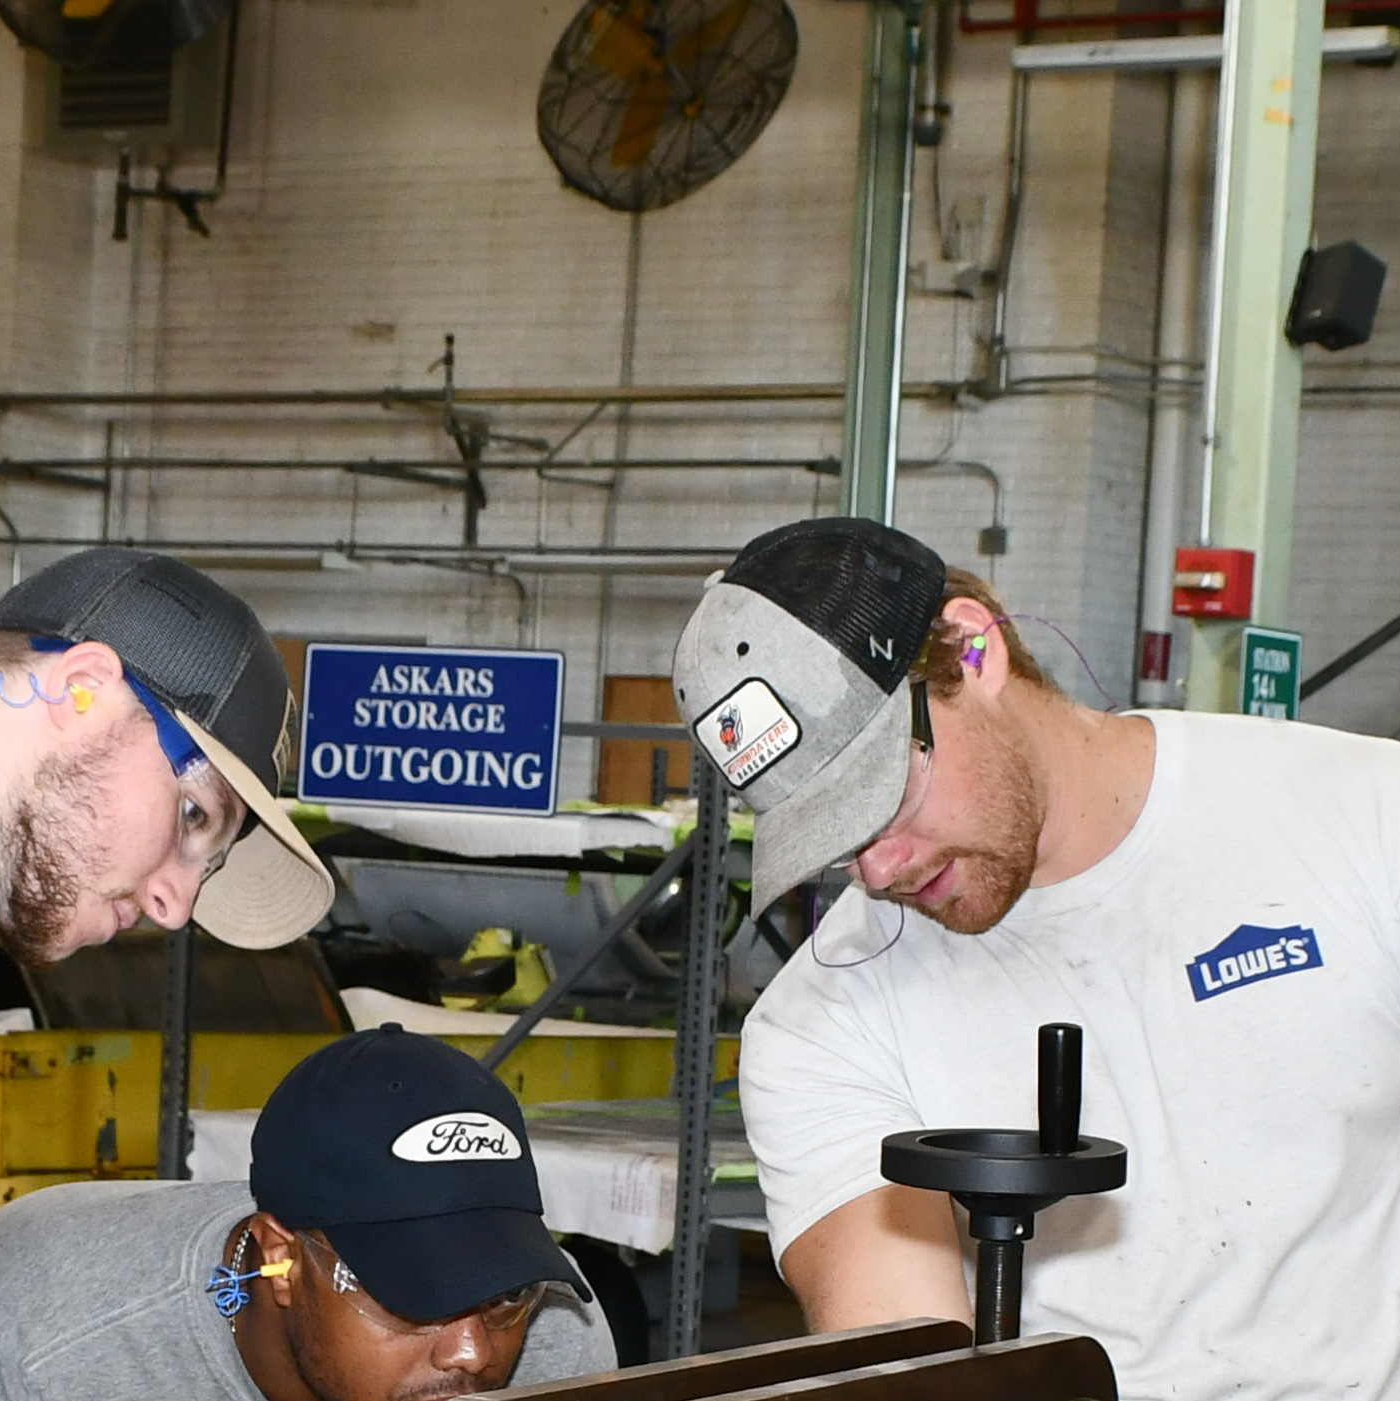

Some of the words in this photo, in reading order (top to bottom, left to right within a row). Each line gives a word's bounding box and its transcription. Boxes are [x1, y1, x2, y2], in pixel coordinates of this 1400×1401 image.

[370, 664, 494, 698] ASKARS
[354, 698, 505, 734] STORAGE
[310, 742, 544, 790] OUTGOING
[1200, 937, 1310, 992] LOWE'S
[426, 1120, 508, 1155] Ford
